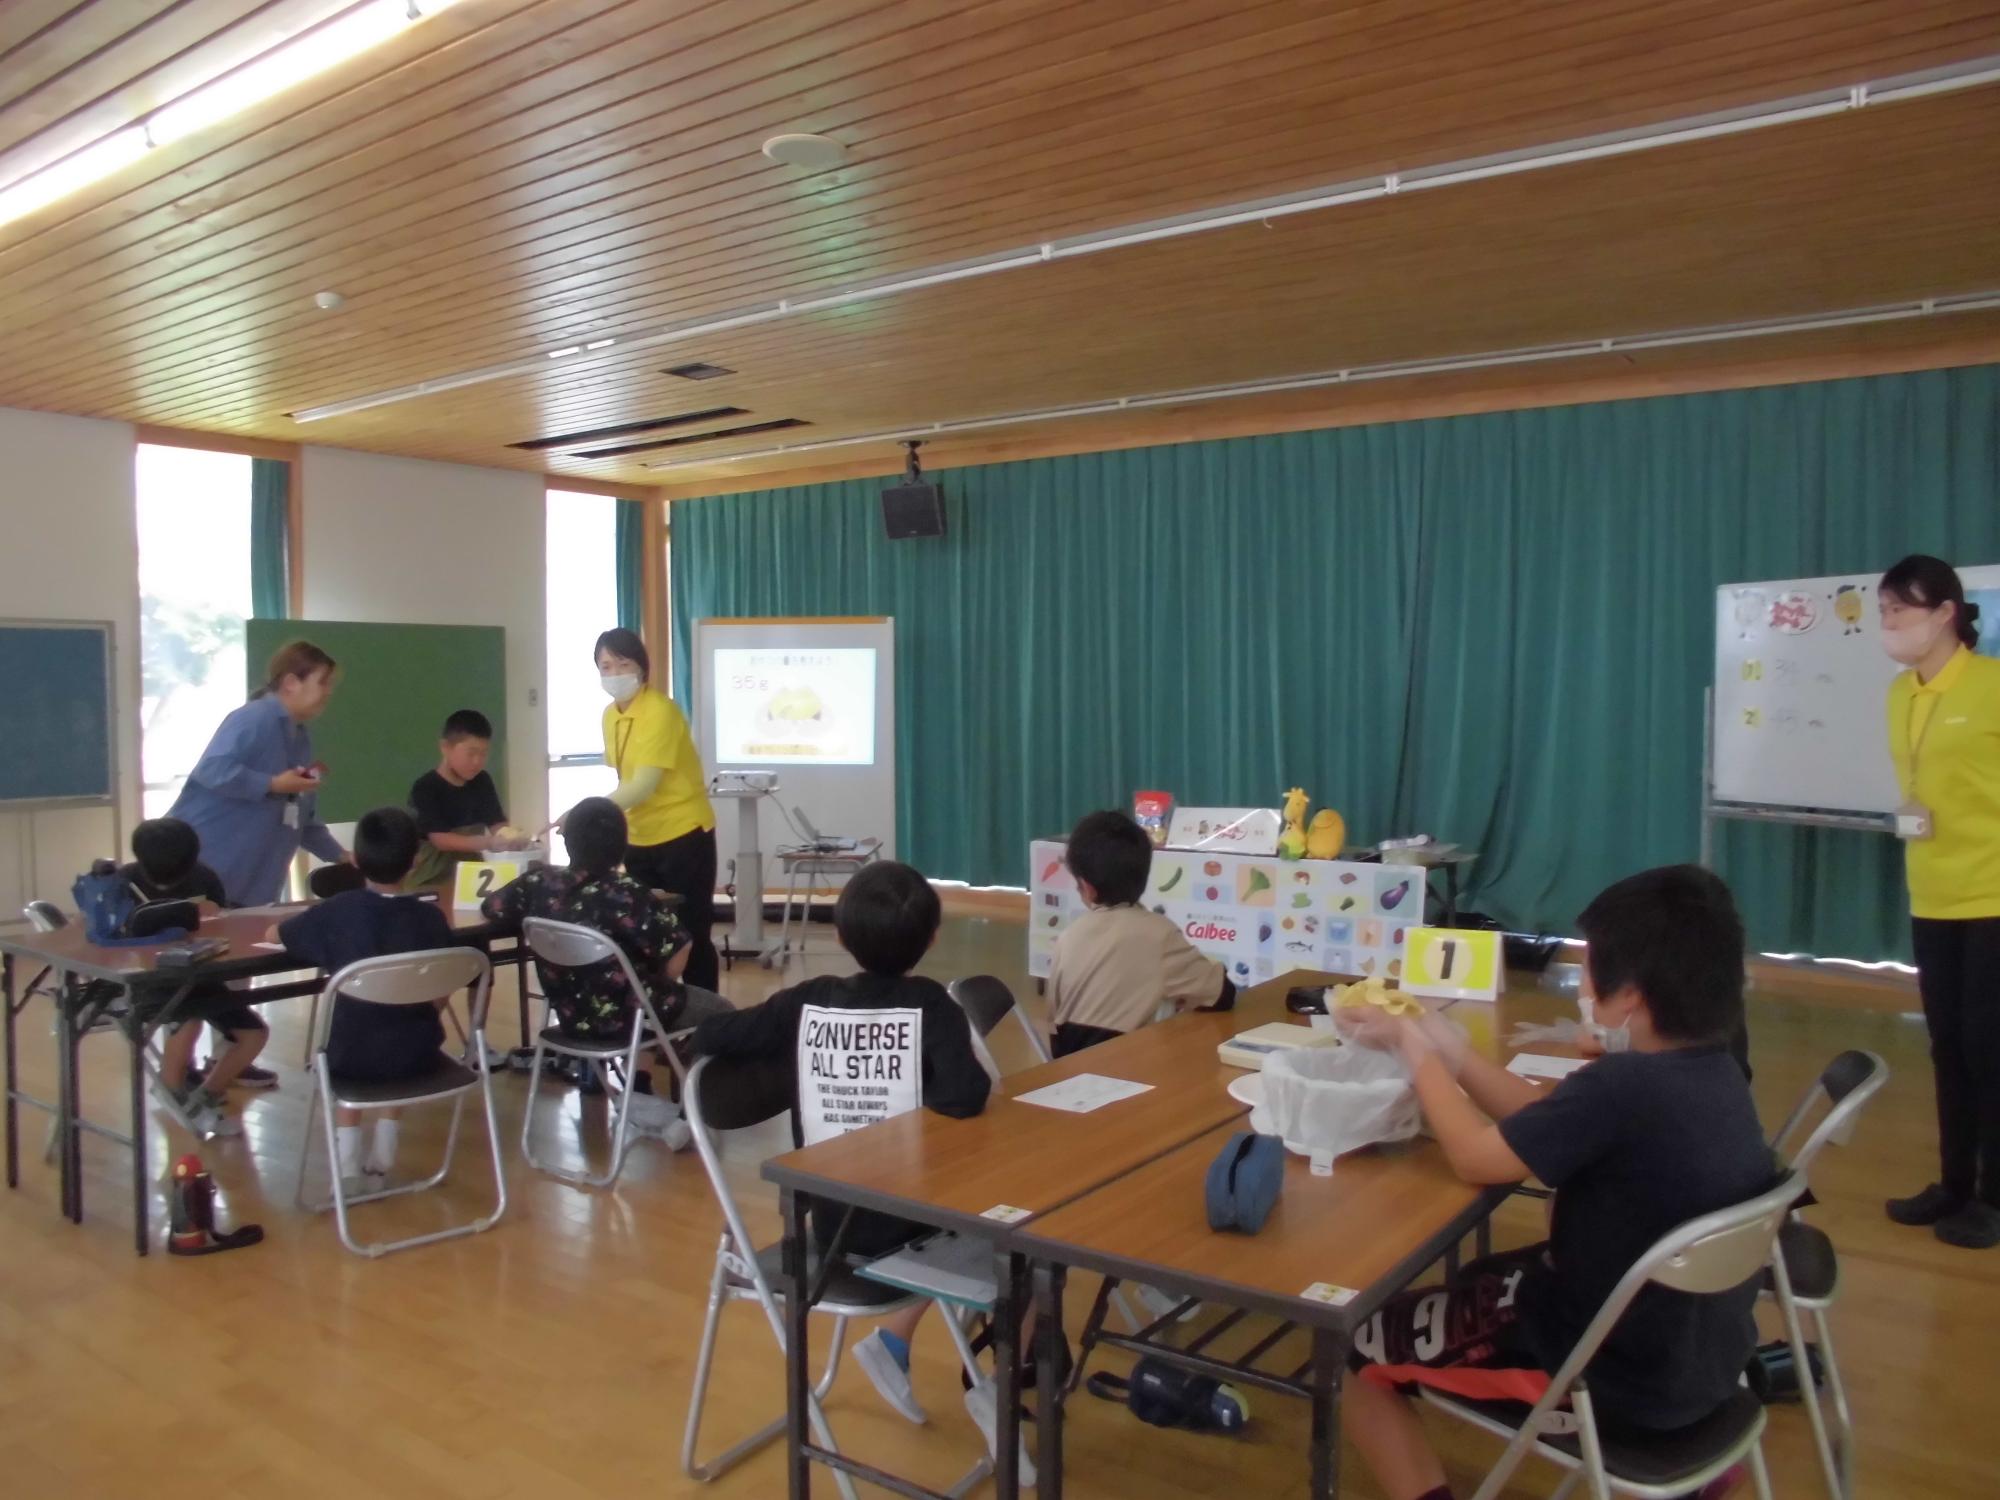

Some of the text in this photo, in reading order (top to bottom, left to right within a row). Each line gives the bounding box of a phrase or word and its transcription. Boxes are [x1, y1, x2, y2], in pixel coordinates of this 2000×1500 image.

[476, 869, 495, 897] 2
[1186, 921, 1236, 942] Calbee
[1440, 941, 1456, 979] 1
[806, 1020, 909, 1050] CONVERSE
[810, 1052, 901, 1080] ALL STAR
[817, 1083, 889, 1096] THE CHUCK TAYLOR
[822, 1099, 887, 1111] ALL STAR ALWAYS
[824, 1114, 840, 1123] HAS
